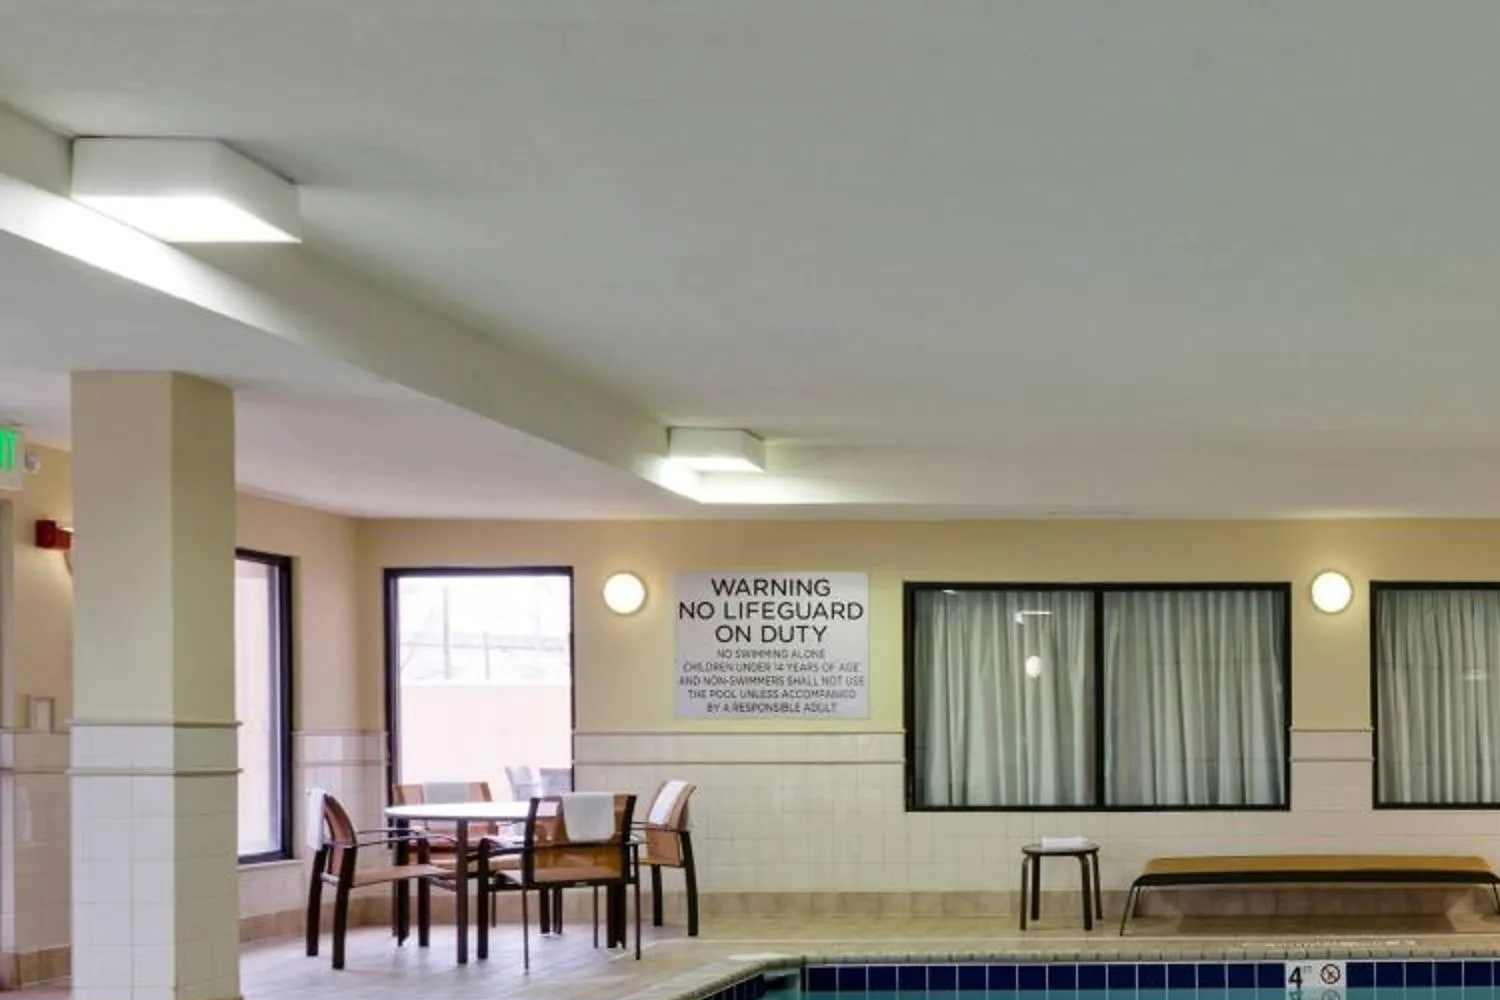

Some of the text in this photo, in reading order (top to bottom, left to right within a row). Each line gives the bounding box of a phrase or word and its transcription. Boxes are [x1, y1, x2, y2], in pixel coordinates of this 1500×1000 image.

[711, 577, 831, 597] WARNING
[679, 601, 865, 621] NO LIFEGUARD
[715, 625, 828, 643] ON DUTY
[717, 649, 825, 659] NO SWIMMING ALONE
[683, 662, 734, 672] CHILDREN
[736, 662, 771, 672] UNDER
[786, 662, 819, 672] YEARS
[822, 662, 836, 672] OF
[839, 662, 859, 672] AGE
[679, 676, 701, 686] AND
[787, 676, 818, 686] SHALL
[822, 676, 842, 686] NOT
[846, 676, 865, 686] USE
[688, 689, 707, 699] THE
[709, 689, 736, 699] POOL
[740, 689, 779, 699] UNLESS
[706, 703, 837, 713] BY A RESPONSIBLE ADULT
